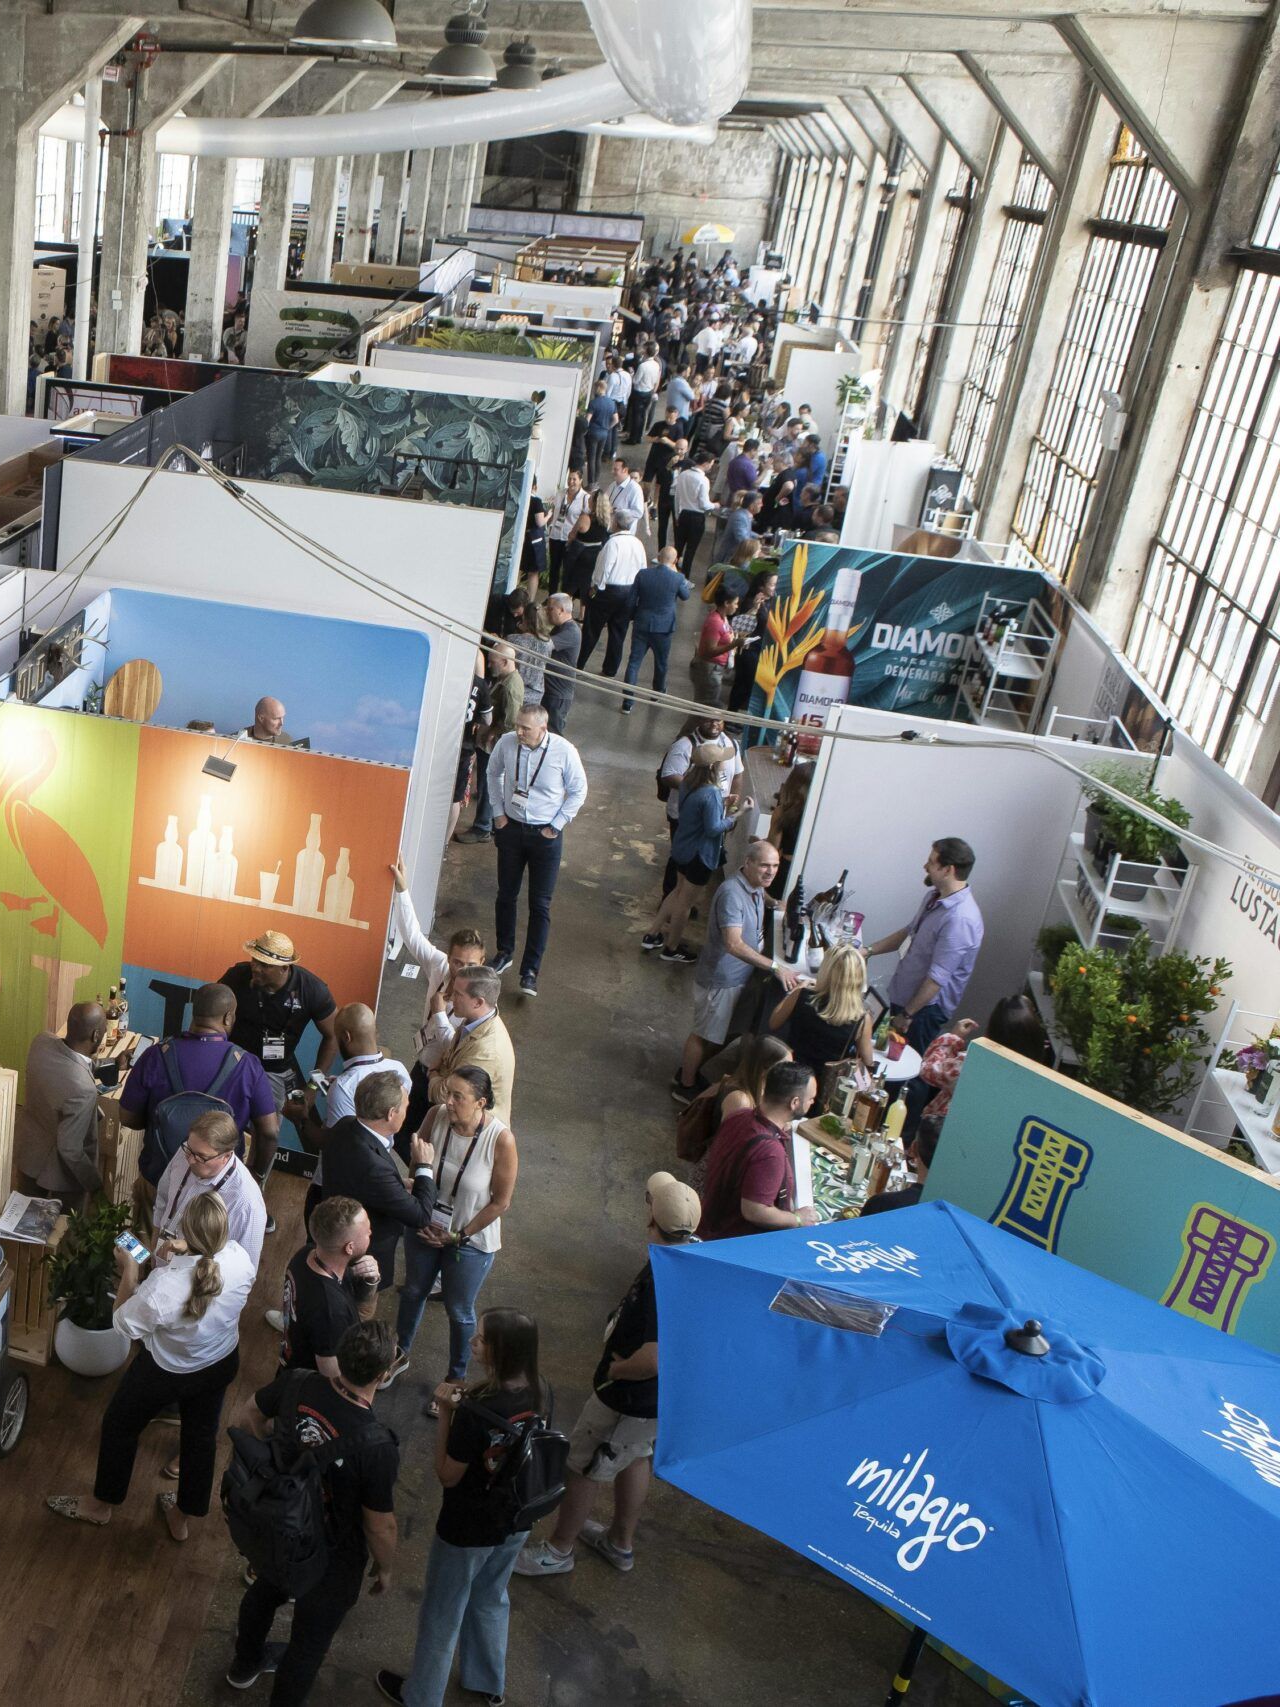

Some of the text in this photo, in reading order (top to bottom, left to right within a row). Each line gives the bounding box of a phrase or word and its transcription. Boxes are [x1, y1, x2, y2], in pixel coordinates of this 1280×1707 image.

[871, 623, 983, 662] DIAMON
[885, 664, 945, 682] DEMERARA
[800, 713, 825, 728] 15
[1230, 875, 1280, 951] LUSTA
[847, 1448, 986, 1572] milagro
[852, 1501, 901, 1540] Tequila
